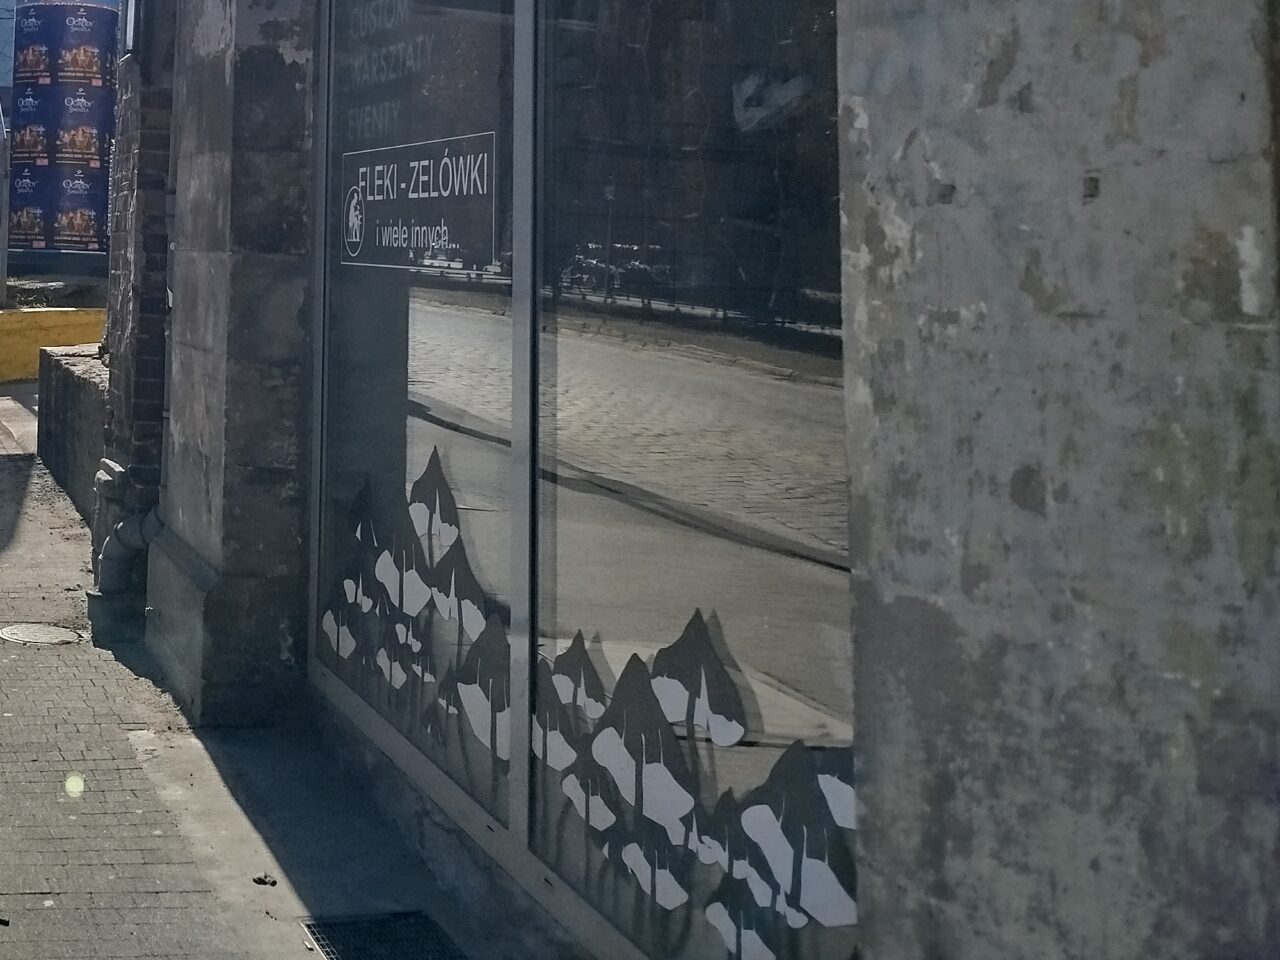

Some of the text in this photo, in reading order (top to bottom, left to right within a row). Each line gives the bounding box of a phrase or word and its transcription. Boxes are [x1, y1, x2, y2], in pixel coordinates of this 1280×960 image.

[349, 32, 436, 87] WARSZTATY
[346, 100, 401, 139] EVENTY
[358, 163, 398, 202] FLEKI
[408, 147, 488, 199] ZELÓWKI
[375, 219, 379, 247] i
[381, 218, 409, 248] wiele
